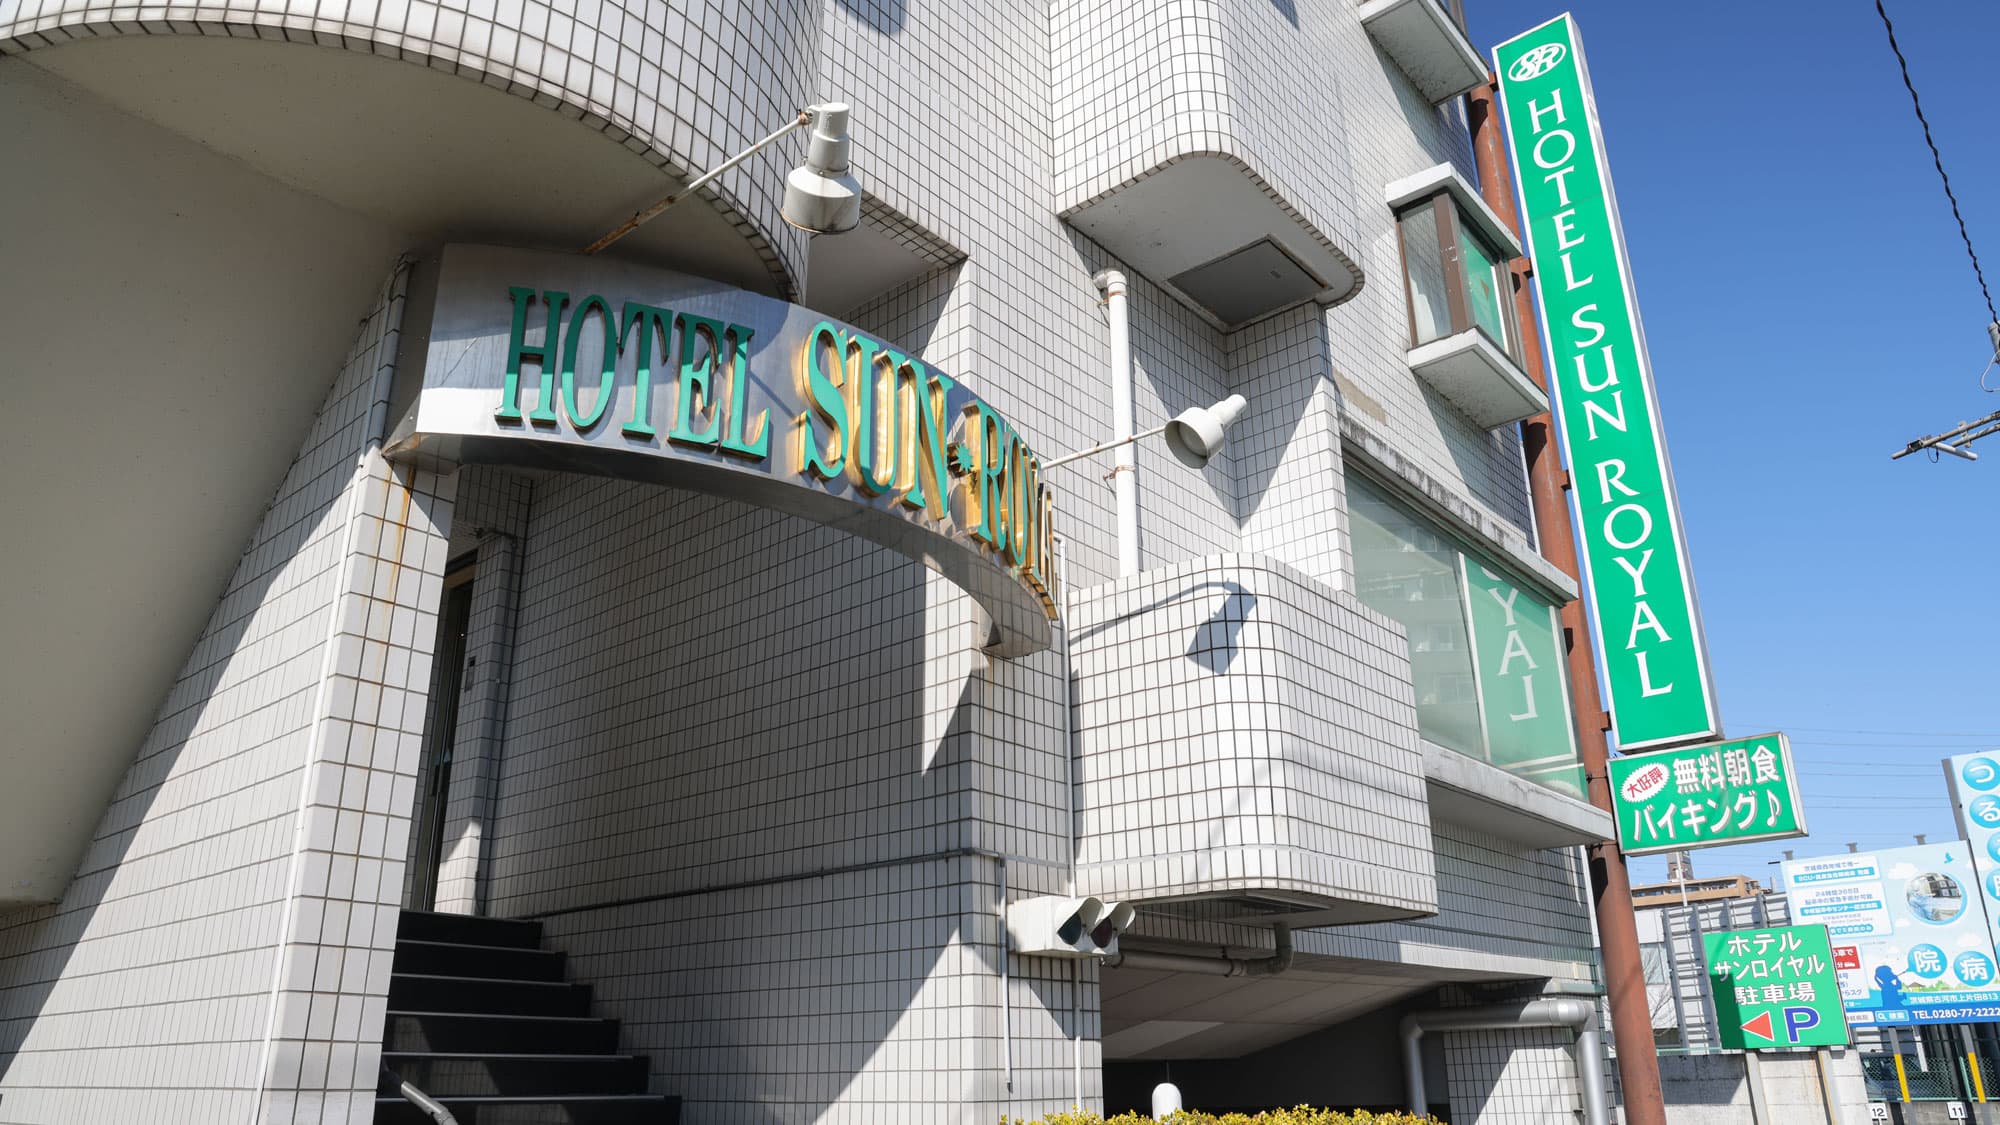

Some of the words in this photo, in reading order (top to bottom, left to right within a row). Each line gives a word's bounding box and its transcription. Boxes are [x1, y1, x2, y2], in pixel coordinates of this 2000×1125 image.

[1528, 87, 1594, 292] HOTEL
[1570, 303, 1628, 442] SUN
[494, 286, 771, 460] HOTEL
[799, 320, 954, 521] SUN
[1595, 458, 1674, 698] ROYAL
[1627, 766, 1664, 799] 大好評
[1673, 744, 1781, 795] 無料朝食
[1633, 789, 1758, 842] バイキング
[1727, 931, 1802, 957] ホテル
[1714, 954, 1825, 982] サンロイヤル
[1734, 981, 1816, 1006] 駐車場
[1783, 1006, 1820, 1044] P
[1871, 1107, 1885, 1117] 12
[1952, 1107, 1965, 1117] 11
